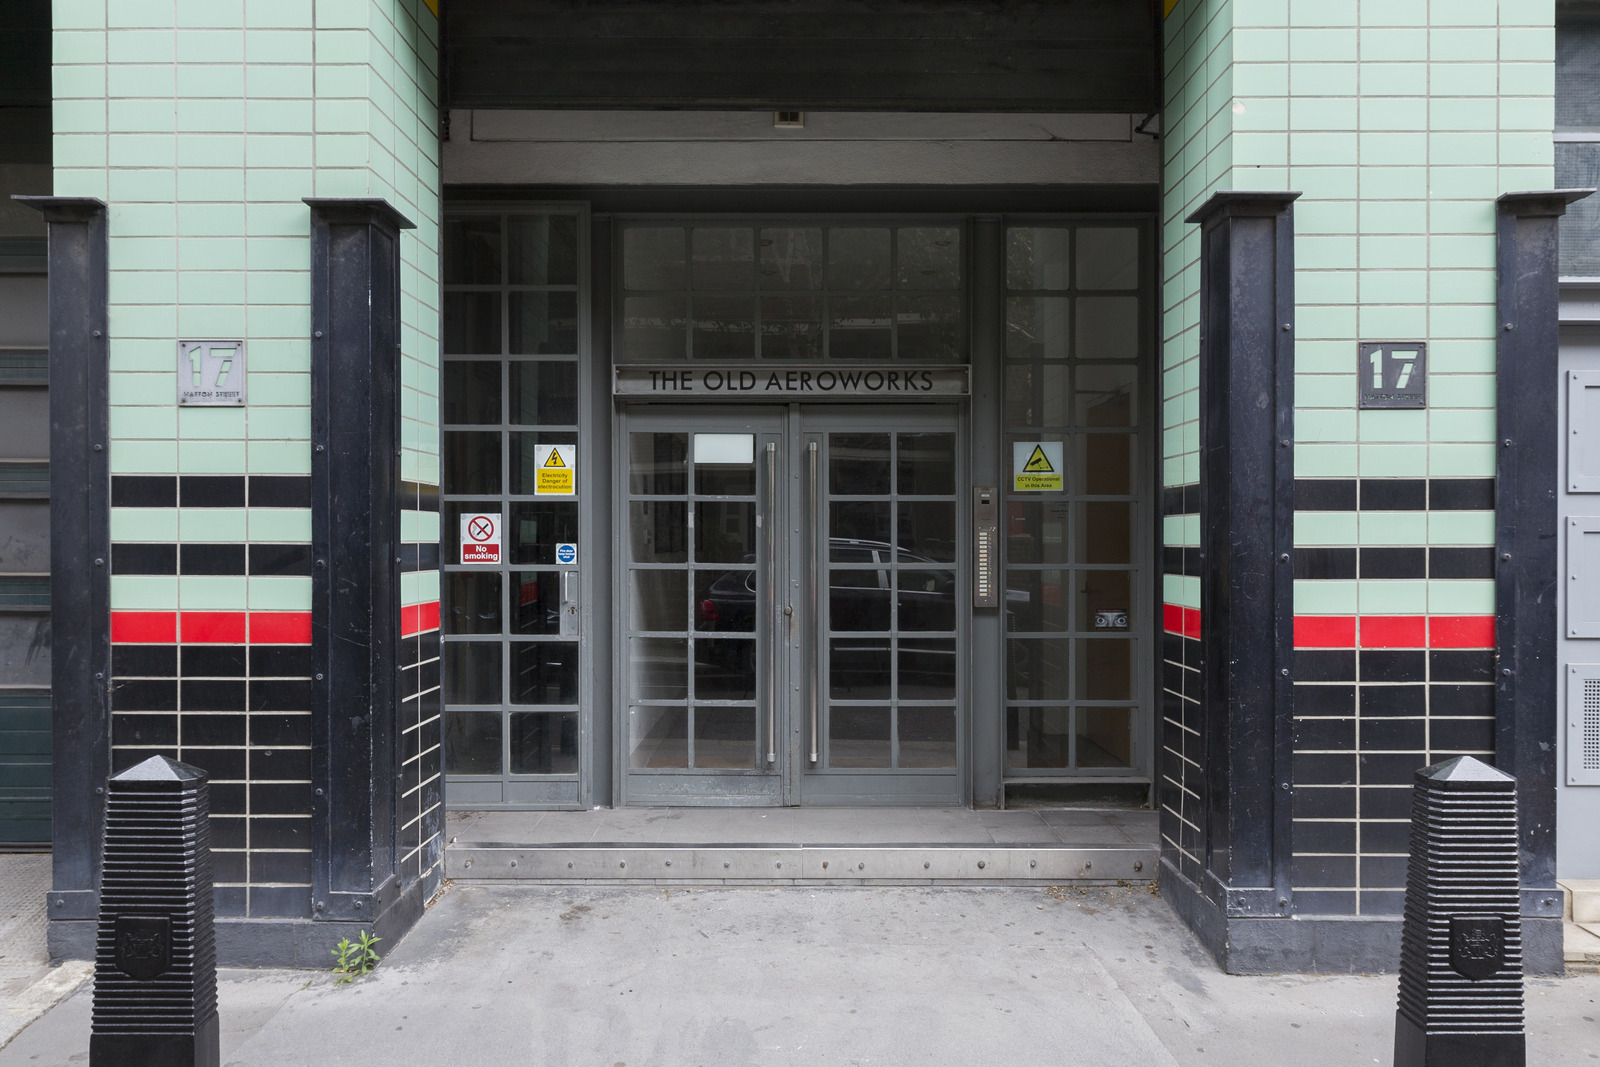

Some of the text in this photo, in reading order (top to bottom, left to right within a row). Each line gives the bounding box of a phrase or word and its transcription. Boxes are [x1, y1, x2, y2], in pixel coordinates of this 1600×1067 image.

[189, 346, 237, 387] 17
[648, 370, 933, 391] THE OLD AEROWORKS
[1370, 348, 1419, 389] 17
[464, 552, 498, 561] smoking
